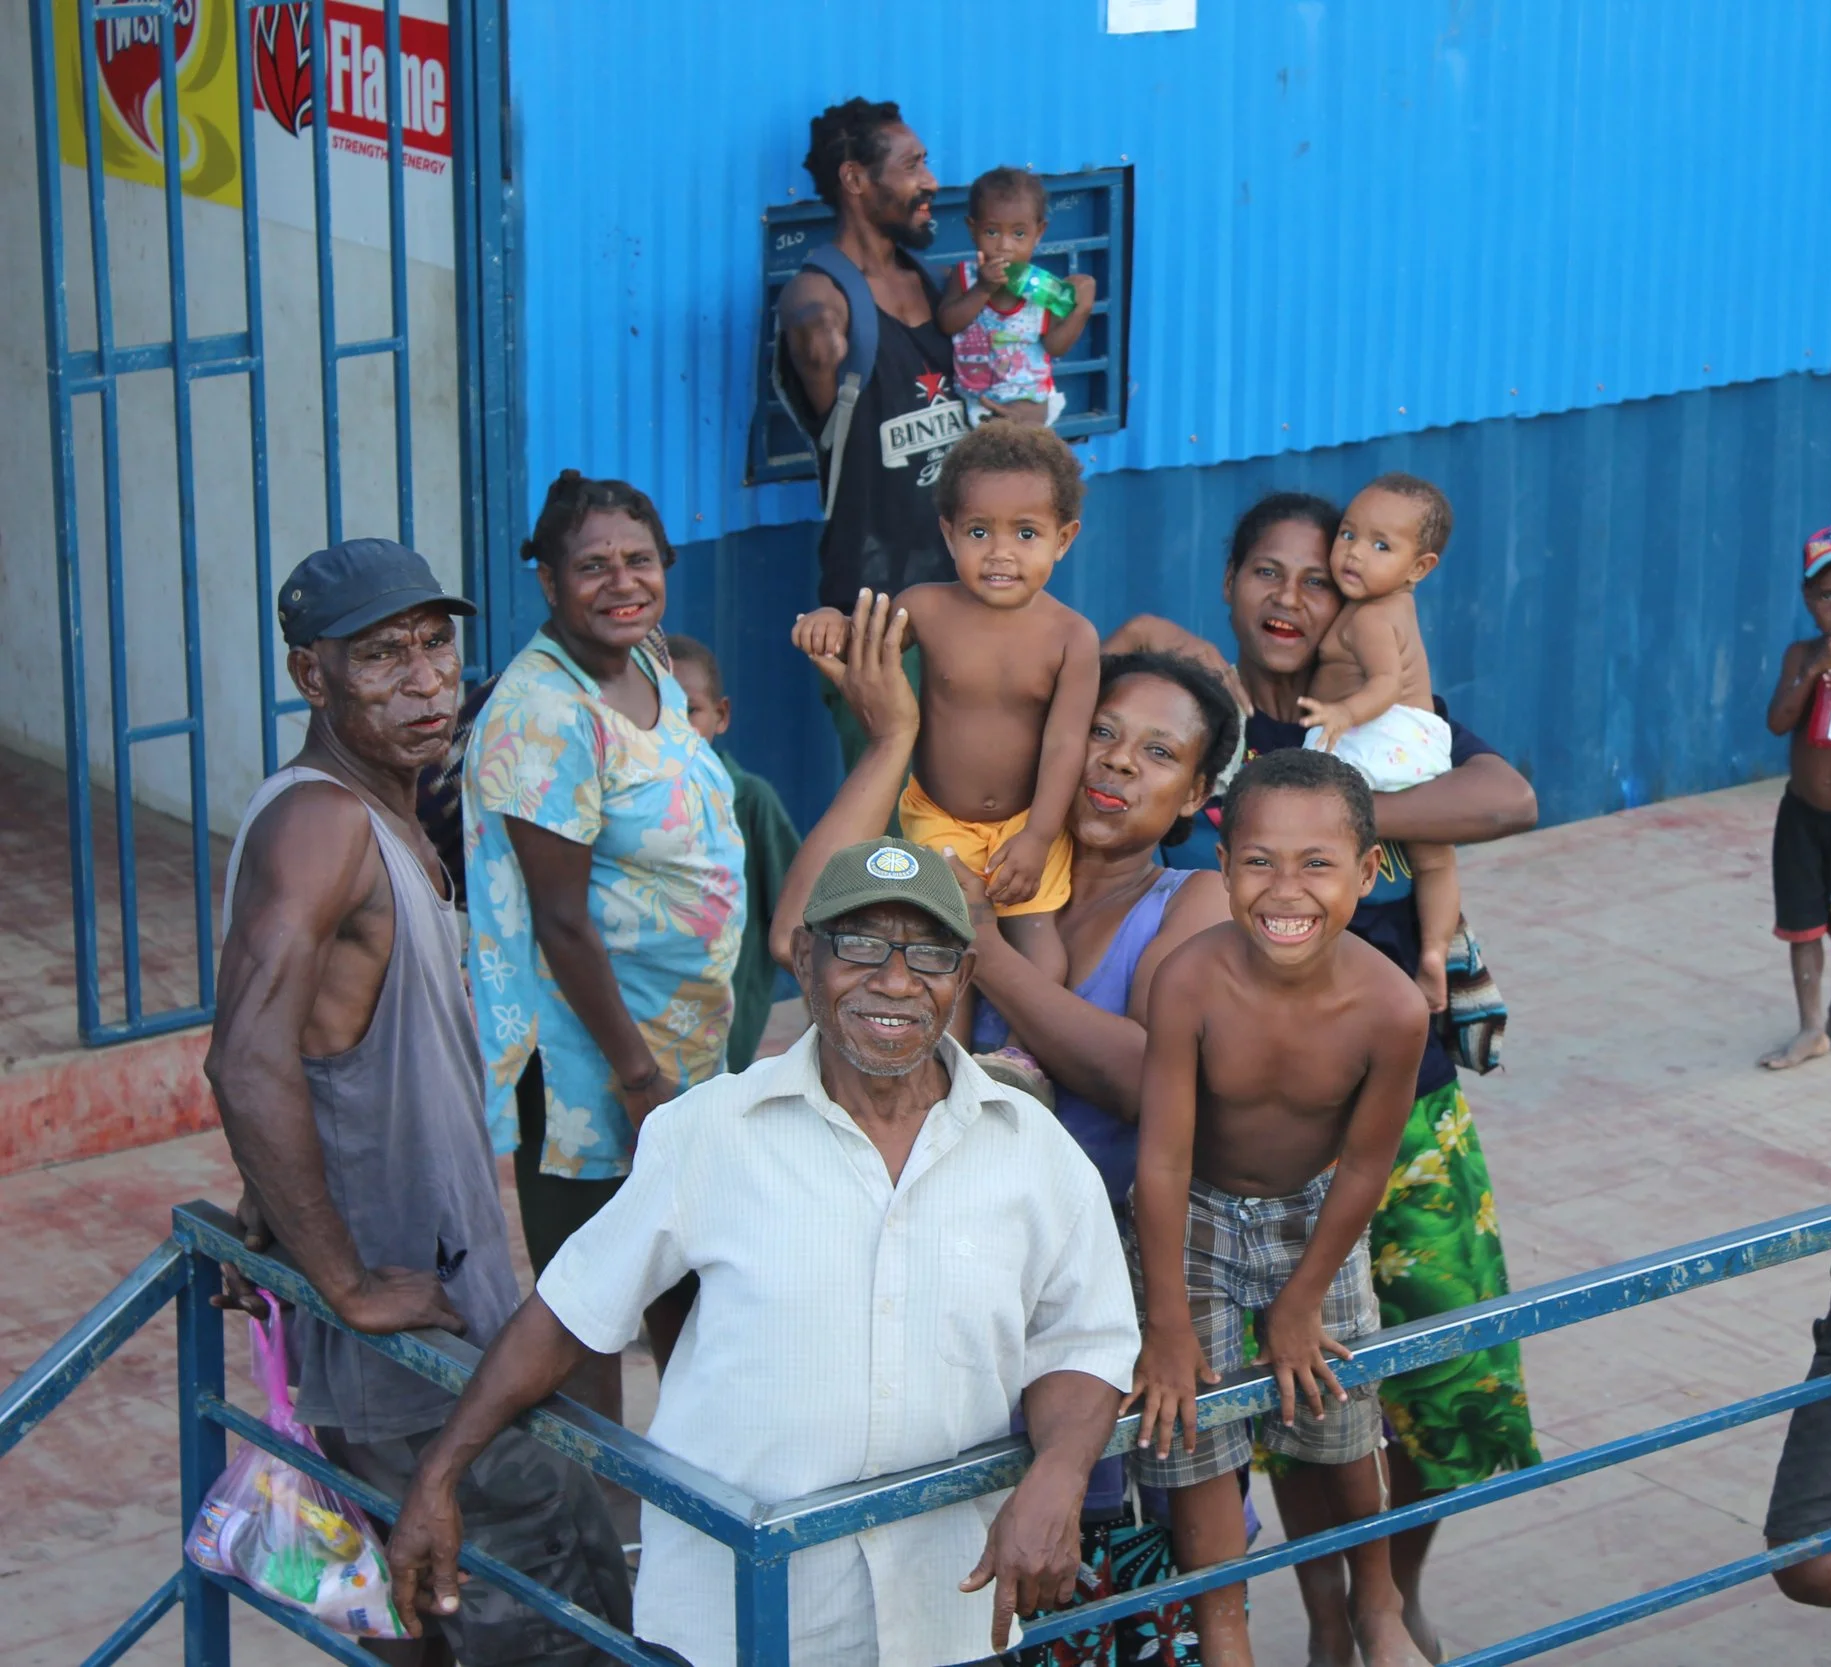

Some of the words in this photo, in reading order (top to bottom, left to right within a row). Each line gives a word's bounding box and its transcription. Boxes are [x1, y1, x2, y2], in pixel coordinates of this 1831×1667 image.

[329, 18, 446, 137] Flame
[332, 135, 389, 161] STRENGTH
[402, 152, 446, 175] ENERGY
[889, 409, 962, 450] BINTA
